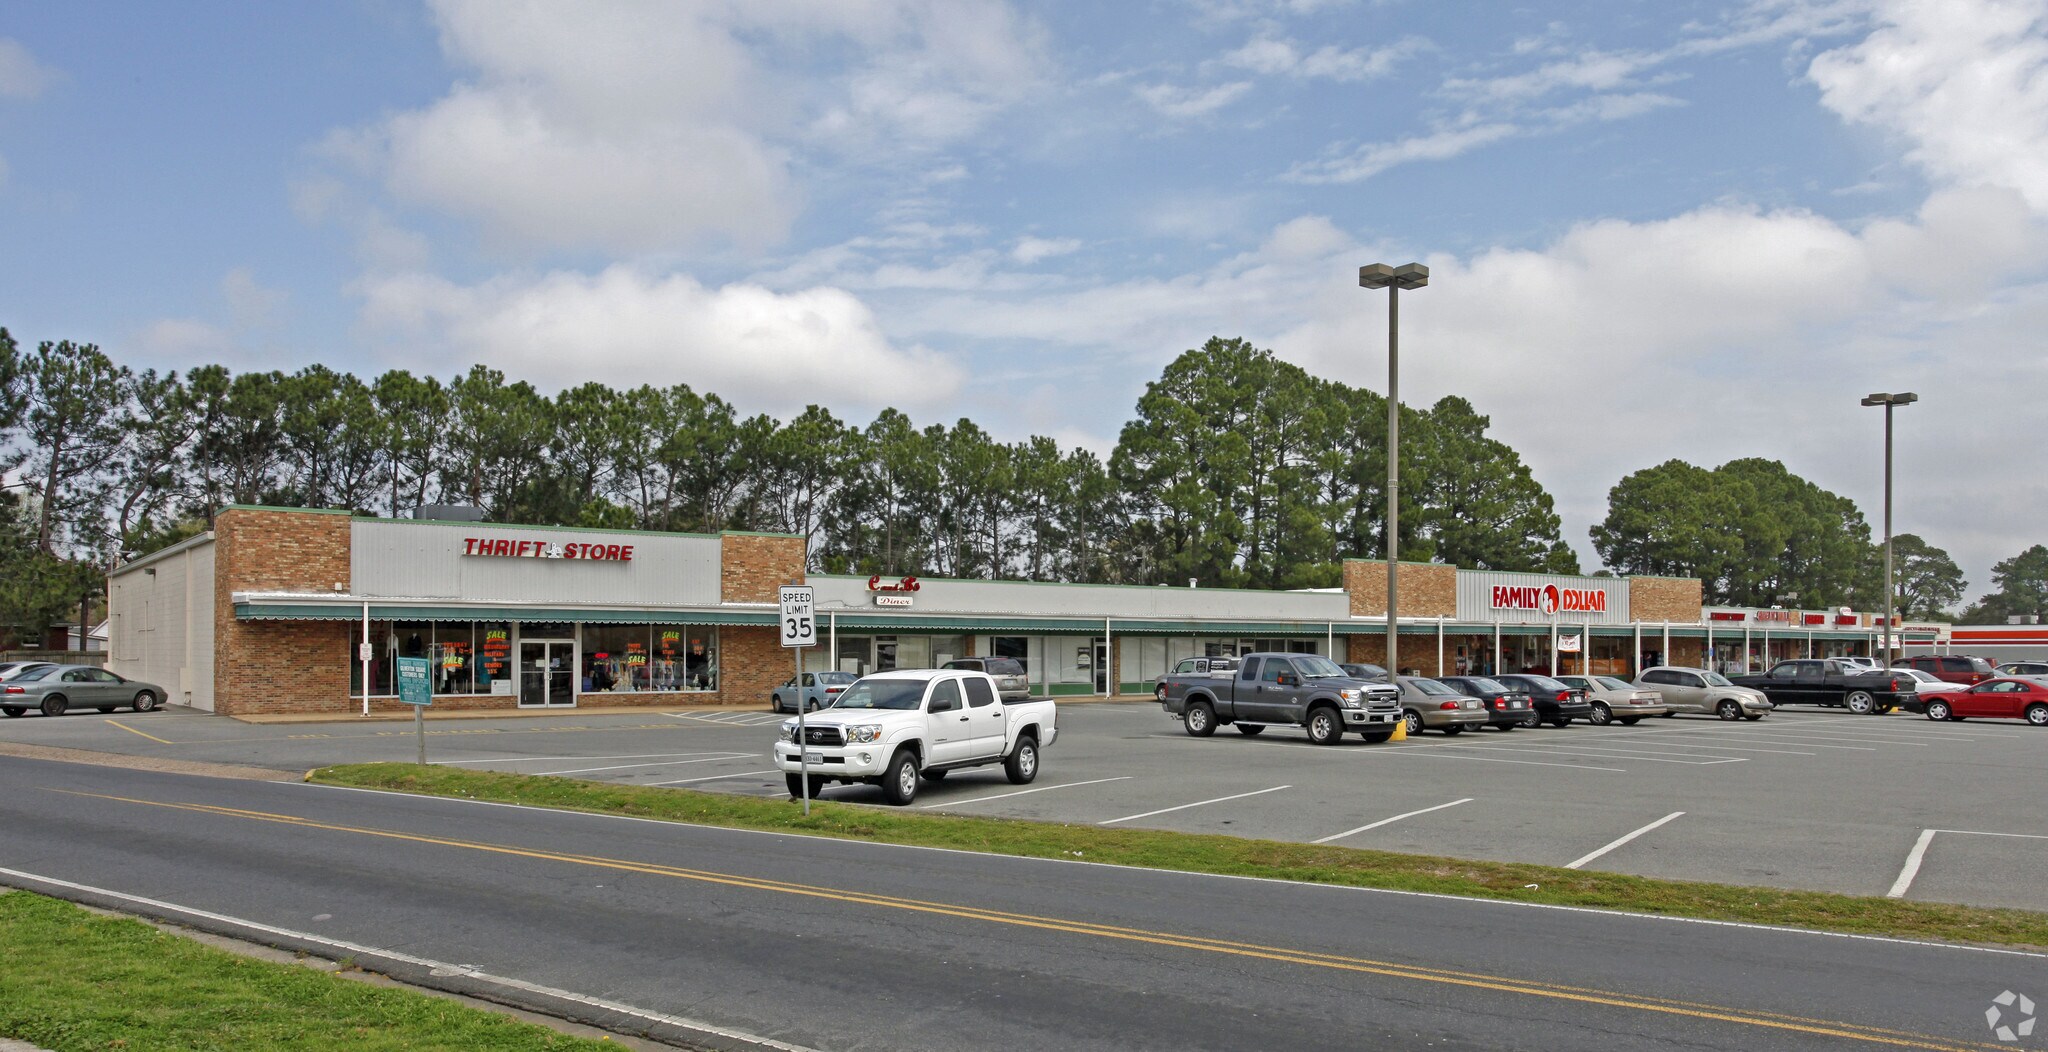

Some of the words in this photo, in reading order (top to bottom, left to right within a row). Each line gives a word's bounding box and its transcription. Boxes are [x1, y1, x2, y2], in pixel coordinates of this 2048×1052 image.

[464, 538, 546, 556] THRIFT
[563, 542, 634, 561] STORE
[782, 593, 811, 603] SPEED
[880, 597, 911, 605] Diner
[1493, 586, 1541, 608] FAMILY
[1563, 589, 1606, 611] DOLLAR
[786, 605, 809, 615] LIMIT
[786, 618, 812, 639] 35
[486, 630, 507, 640] SALE
[661, 631, 680, 640] SALE
[442, 655, 464, 665] SALE
[628, 655, 646, 664] SALE
